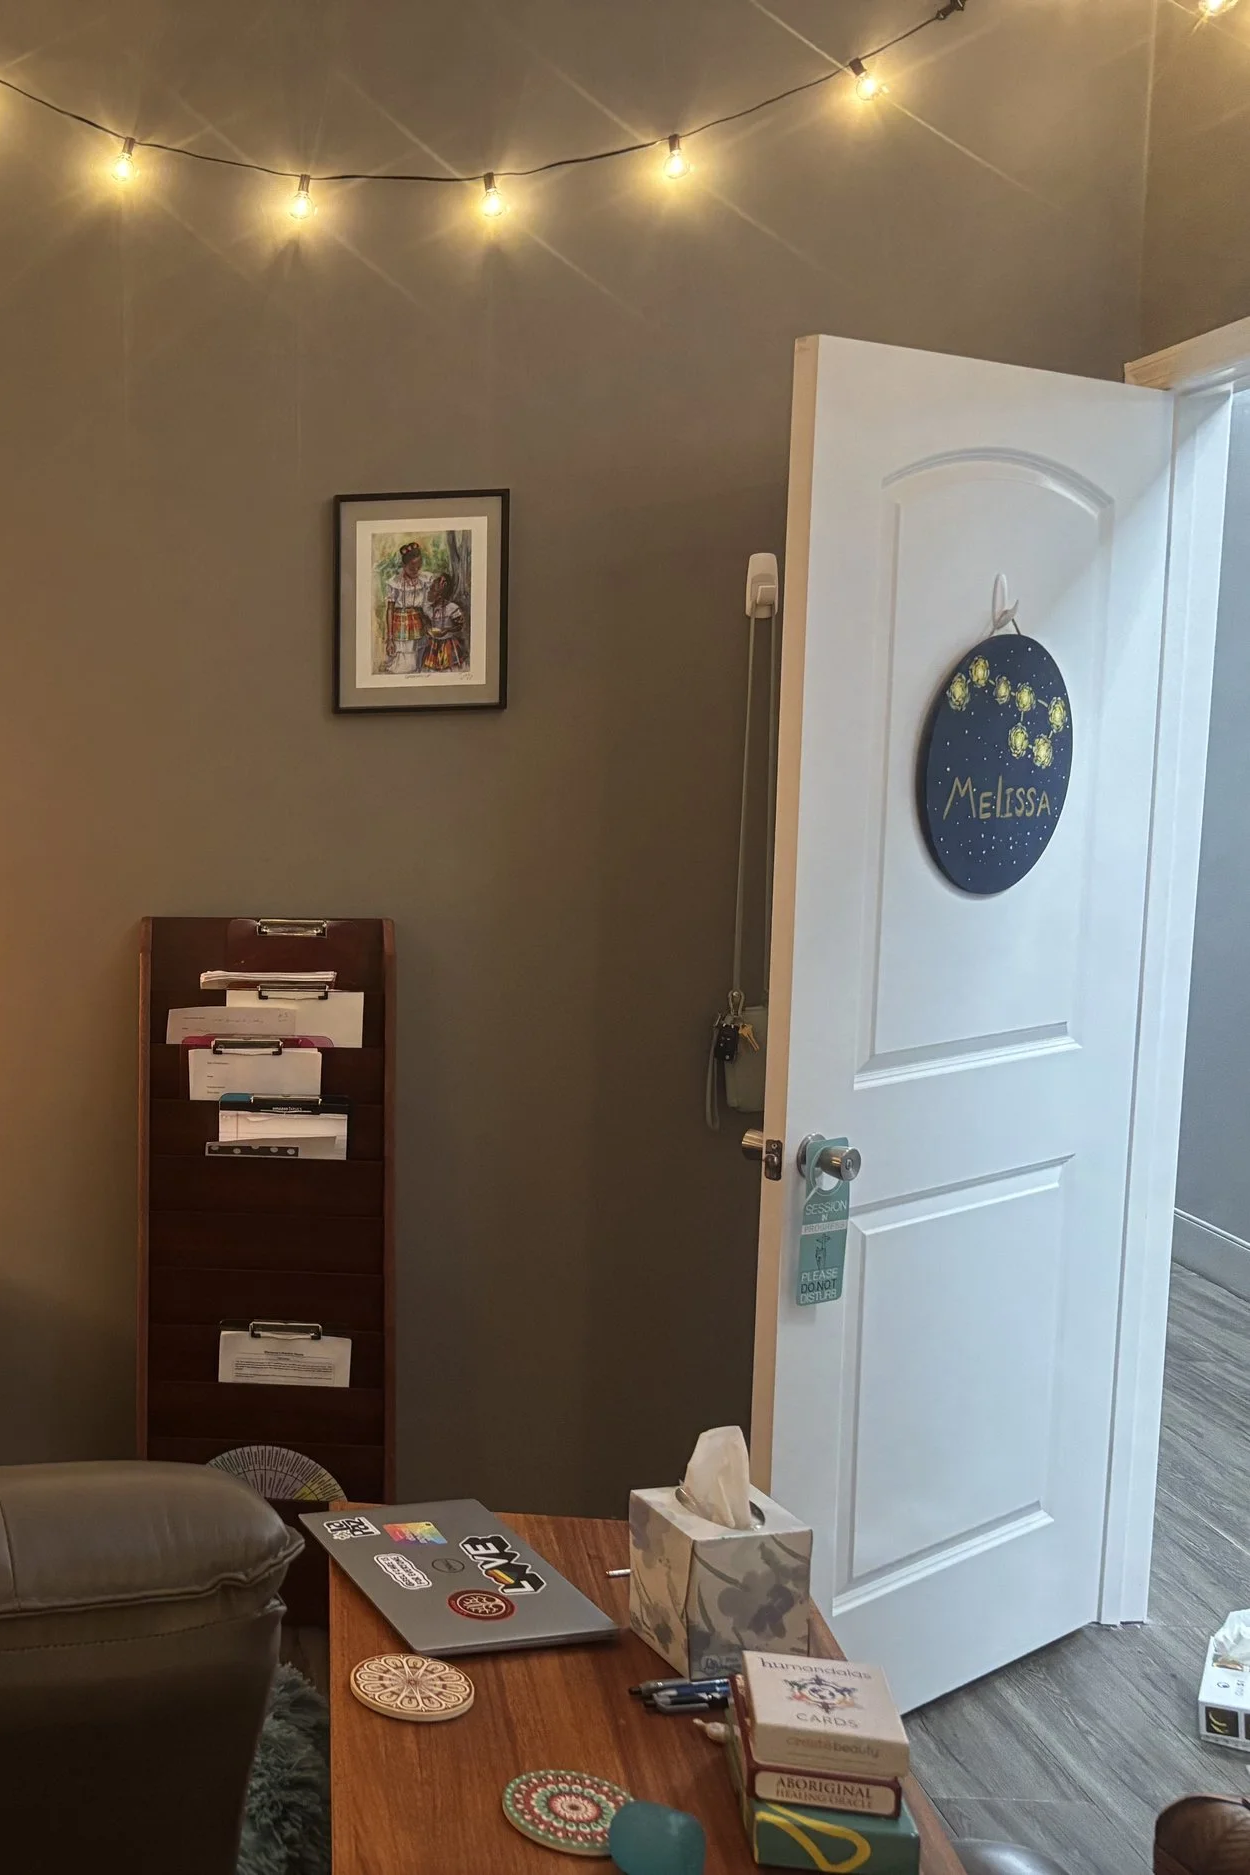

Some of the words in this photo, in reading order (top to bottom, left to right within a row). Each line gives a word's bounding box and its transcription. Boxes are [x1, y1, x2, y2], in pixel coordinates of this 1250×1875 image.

[805, 1200, 847, 1216] SESSION
[822, 1213, 828, 1221] IN
[804, 1221, 847, 1233] PROGRESS
[801, 1267, 839, 1282] PLEASE
[800, 1282, 816, 1294] DO
[816, 1279, 837, 1292] NOT
[800, 1288, 838, 1304] DISTURB
[759, 1656, 872, 1680] humandalas
[796, 1712, 859, 1728] CARDS
[776, 1776, 873, 1800] ABORIGINAL
[776, 1789, 827, 1804] HEALING
[828, 1794, 873, 1809] ORACLE
